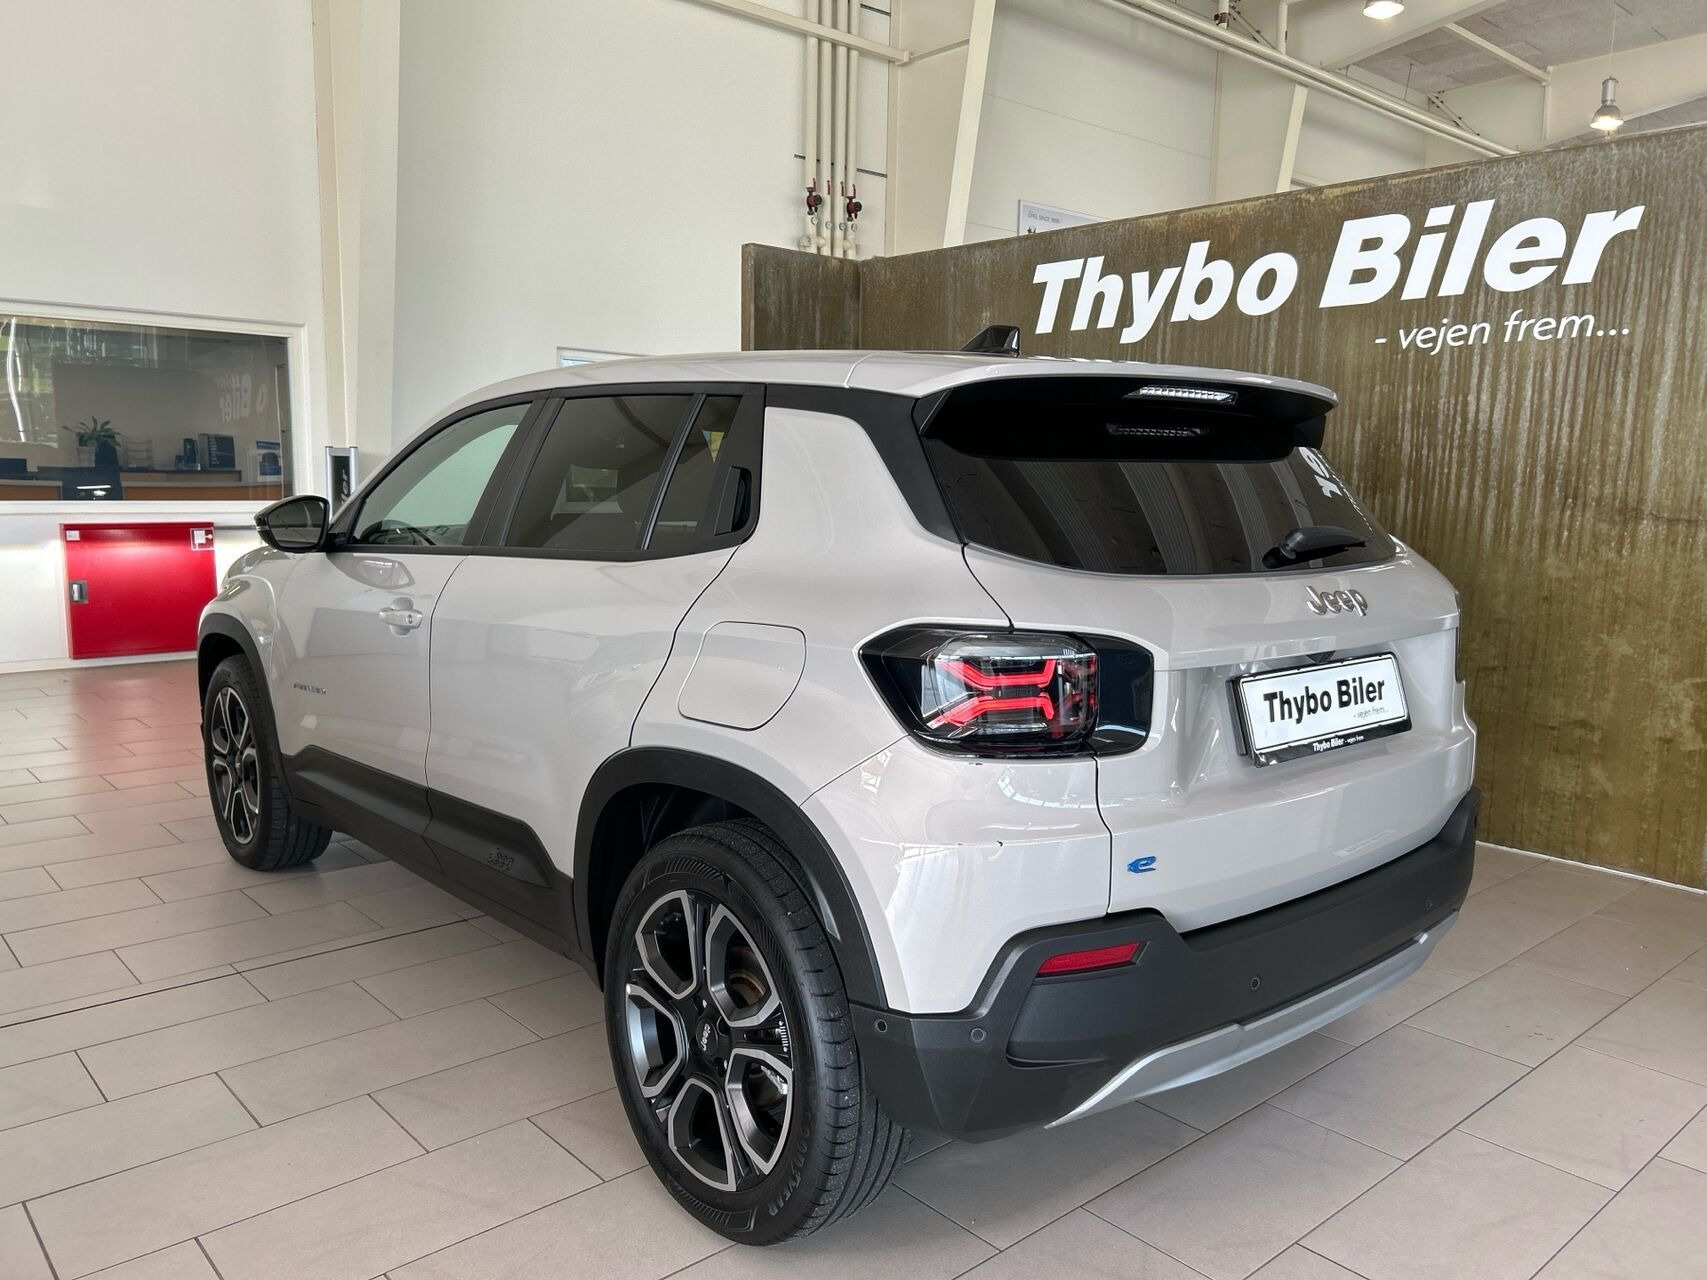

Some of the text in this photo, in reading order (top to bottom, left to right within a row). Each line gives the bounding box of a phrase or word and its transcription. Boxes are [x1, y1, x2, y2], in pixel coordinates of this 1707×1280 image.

[1032, 198, 1646, 344] Thybo Biler
[1399, 322, 1491, 356] vejen
[1503, 308, 1631, 343] frem...
[1306, 585, 1368, 616] Jeep
[1263, 676, 1385, 724] Thybo Biler
[1313, 740, 1331, 752] Thybo
[769, 1113, 812, 1217] OODYEAR
